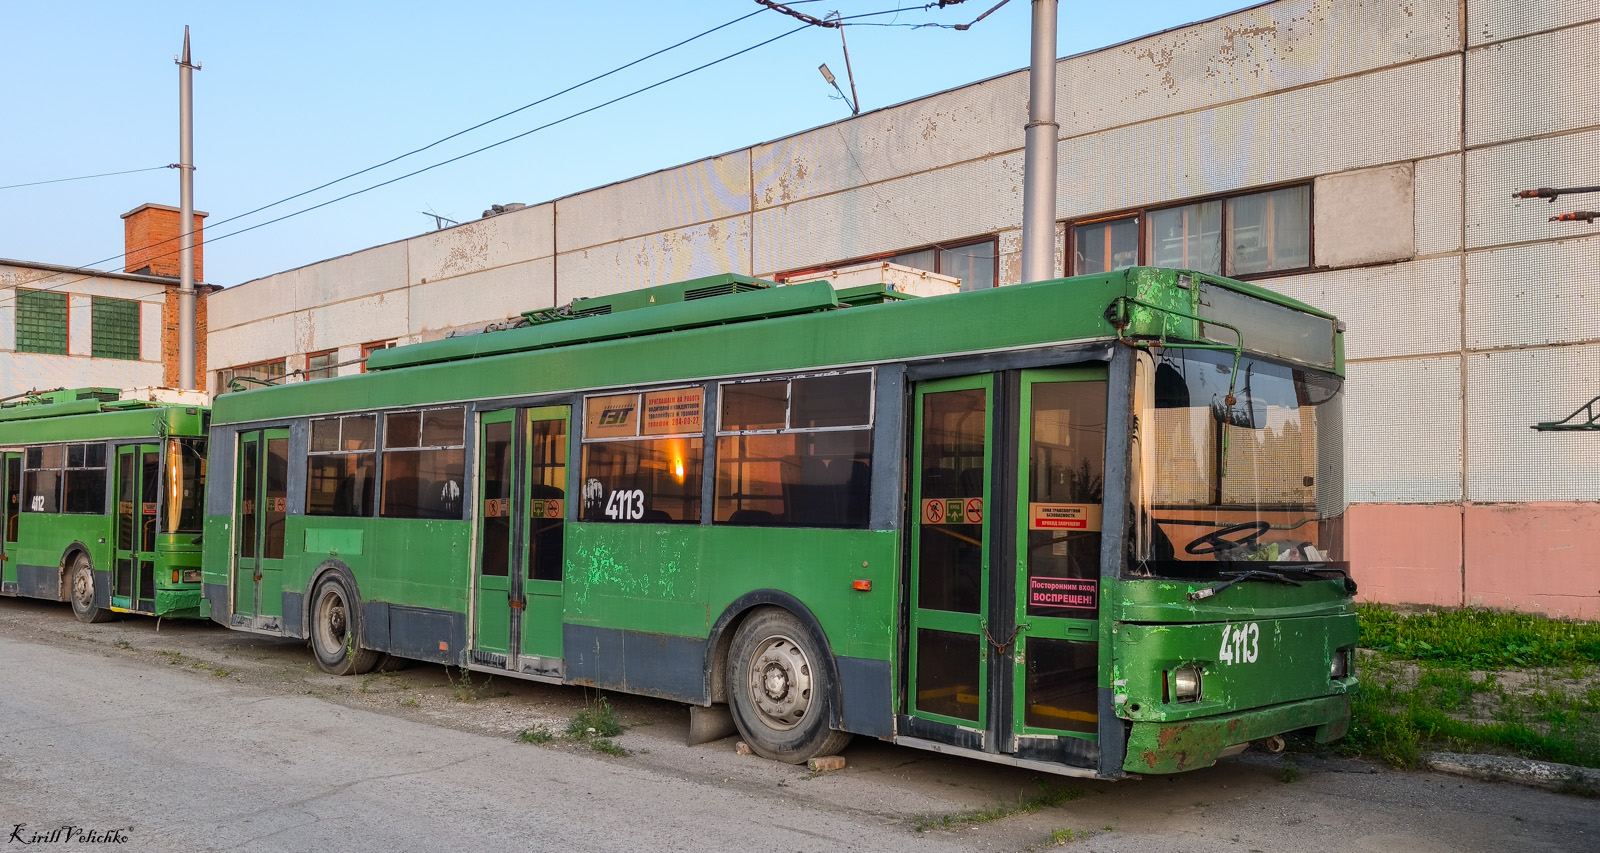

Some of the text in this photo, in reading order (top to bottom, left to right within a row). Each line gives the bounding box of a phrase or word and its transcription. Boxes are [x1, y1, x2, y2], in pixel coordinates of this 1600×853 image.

[599, 407, 634, 425] ГЭТ
[32, 495, 45, 511] 4112
[605, 489, 644, 520] 4113
[1031, 580, 1095, 592] Посторонним вход
[1033, 593, 1092, 605] ВОСПРЕЩЕН!
[1219, 622, 1260, 665] 4113
